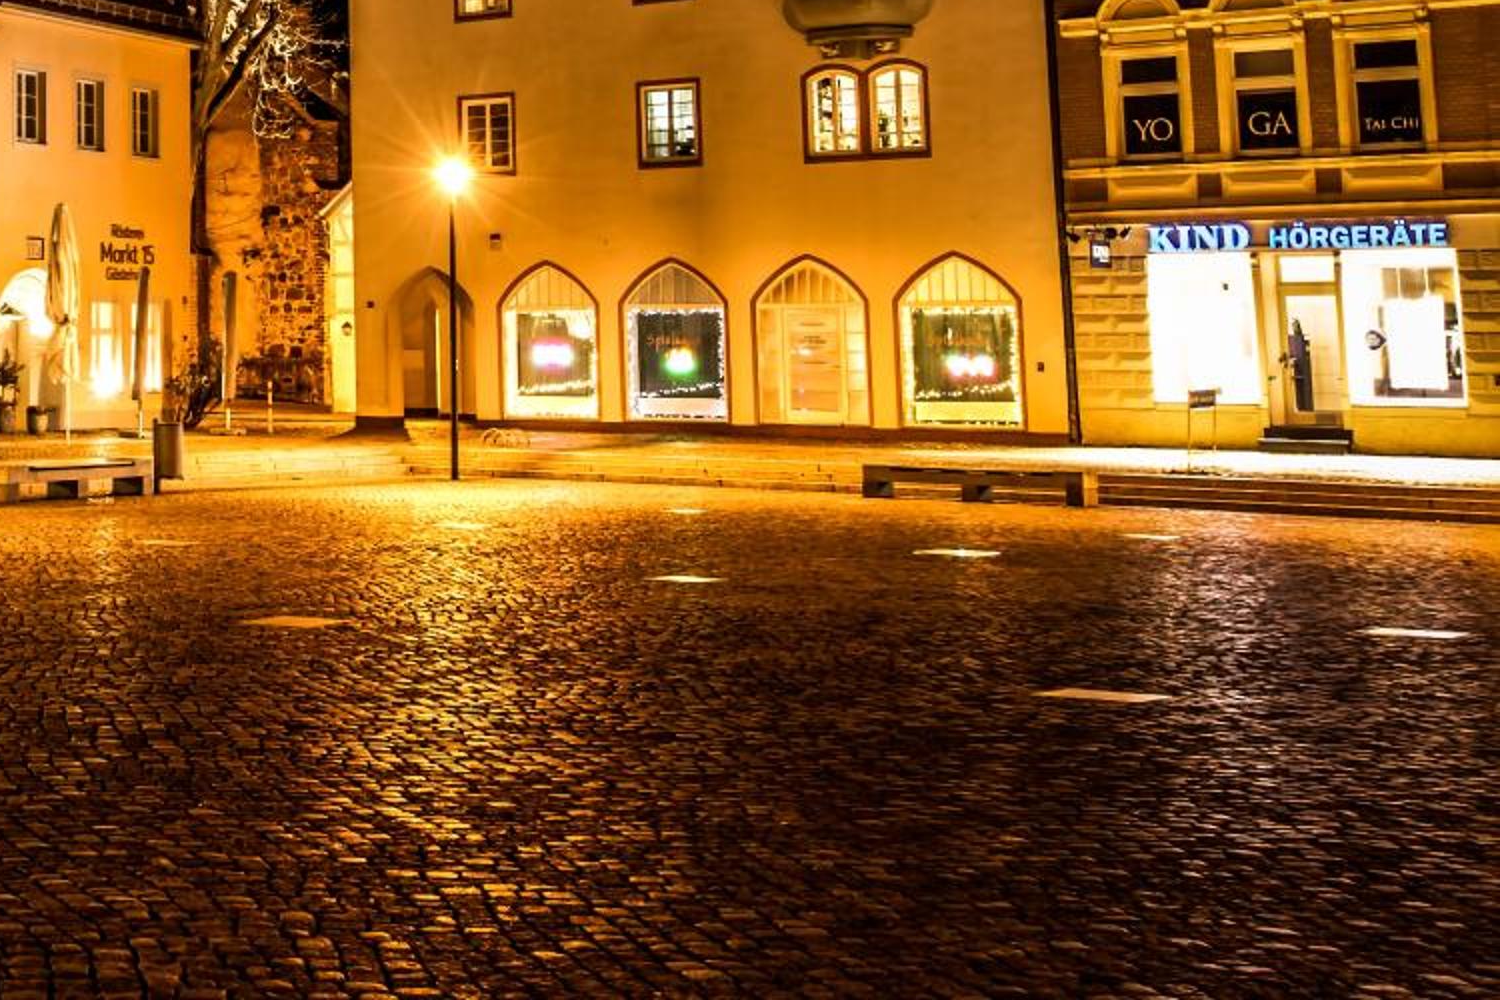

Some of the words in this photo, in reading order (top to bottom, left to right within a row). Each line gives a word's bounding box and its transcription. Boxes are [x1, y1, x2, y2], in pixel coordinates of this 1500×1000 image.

[1132, 117, 1173, 142] YO
[1247, 111, 1292, 136] GA
[1148, 222, 1250, 253] KIND
[1268, 219, 1447, 249] HÖRGERÄTE
[100, 241, 139, 265] Markt
